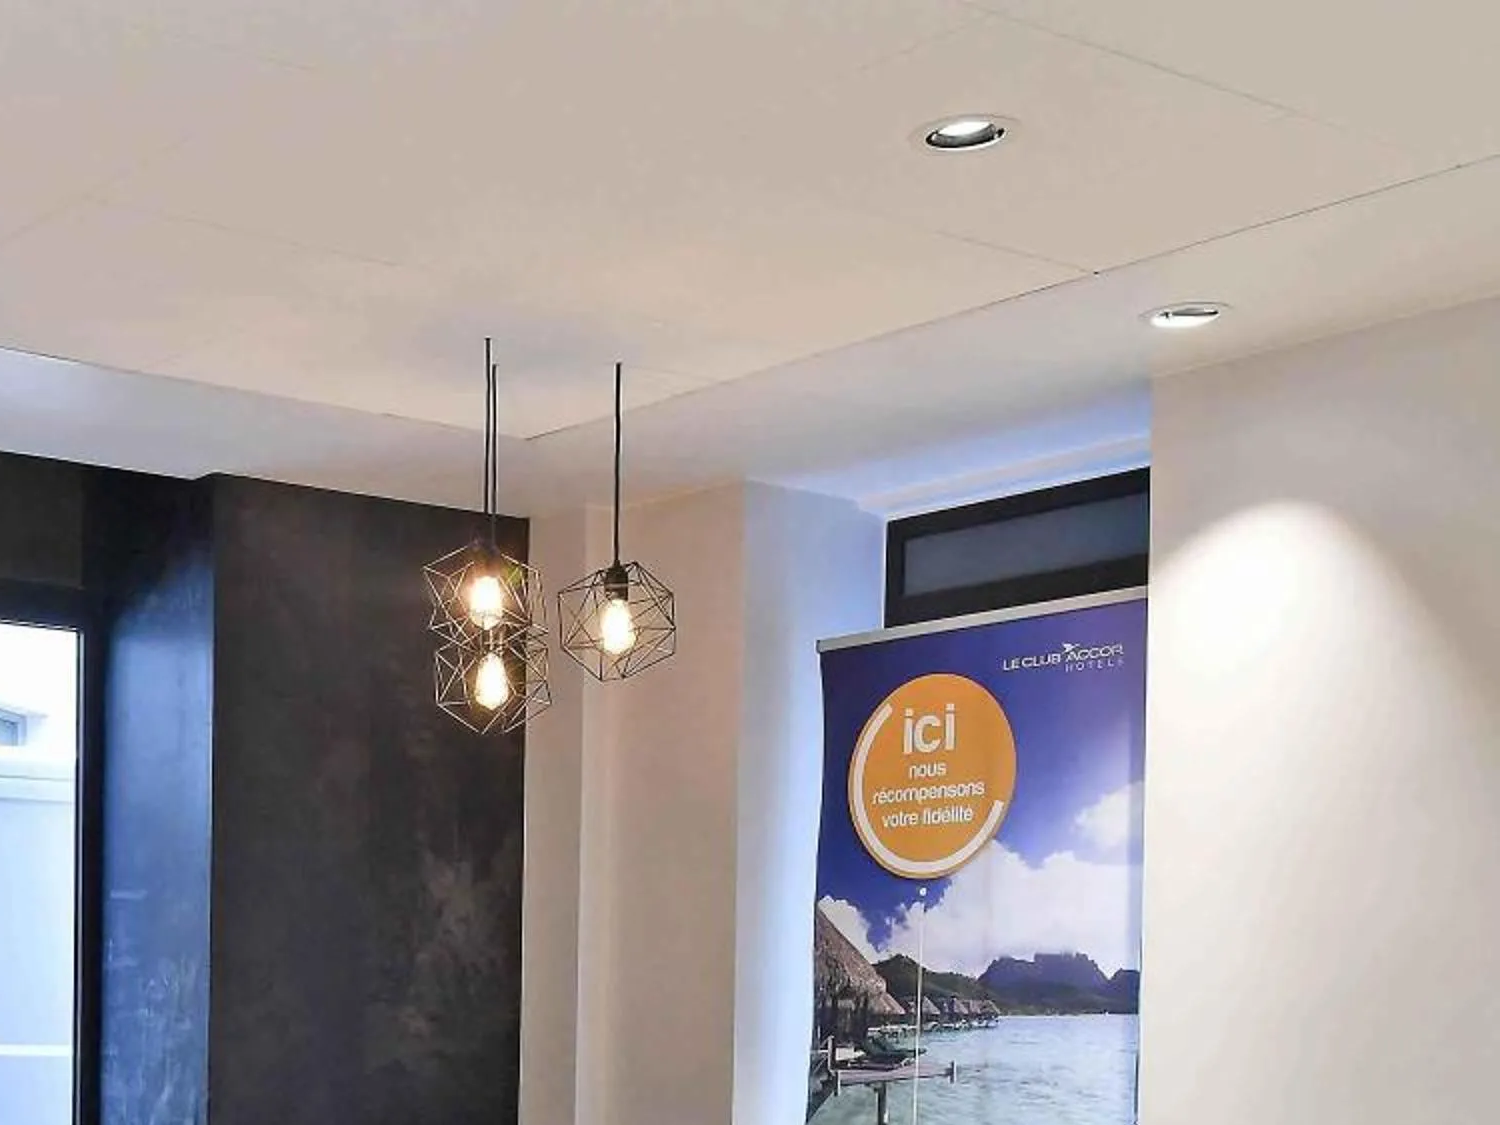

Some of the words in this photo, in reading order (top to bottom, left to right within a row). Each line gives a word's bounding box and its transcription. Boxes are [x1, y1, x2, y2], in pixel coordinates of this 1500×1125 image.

[1003, 658, 1019, 671] LE
[1021, 653, 1061, 668] CLUB
[1065, 644, 1124, 662] ACCOR
[903, 703, 956, 755] ici
[908, 762, 947, 780] nous
[871, 781, 985, 804] récompensons
[882, 811, 918, 827] votre
[923, 804, 973, 825] fidélité
